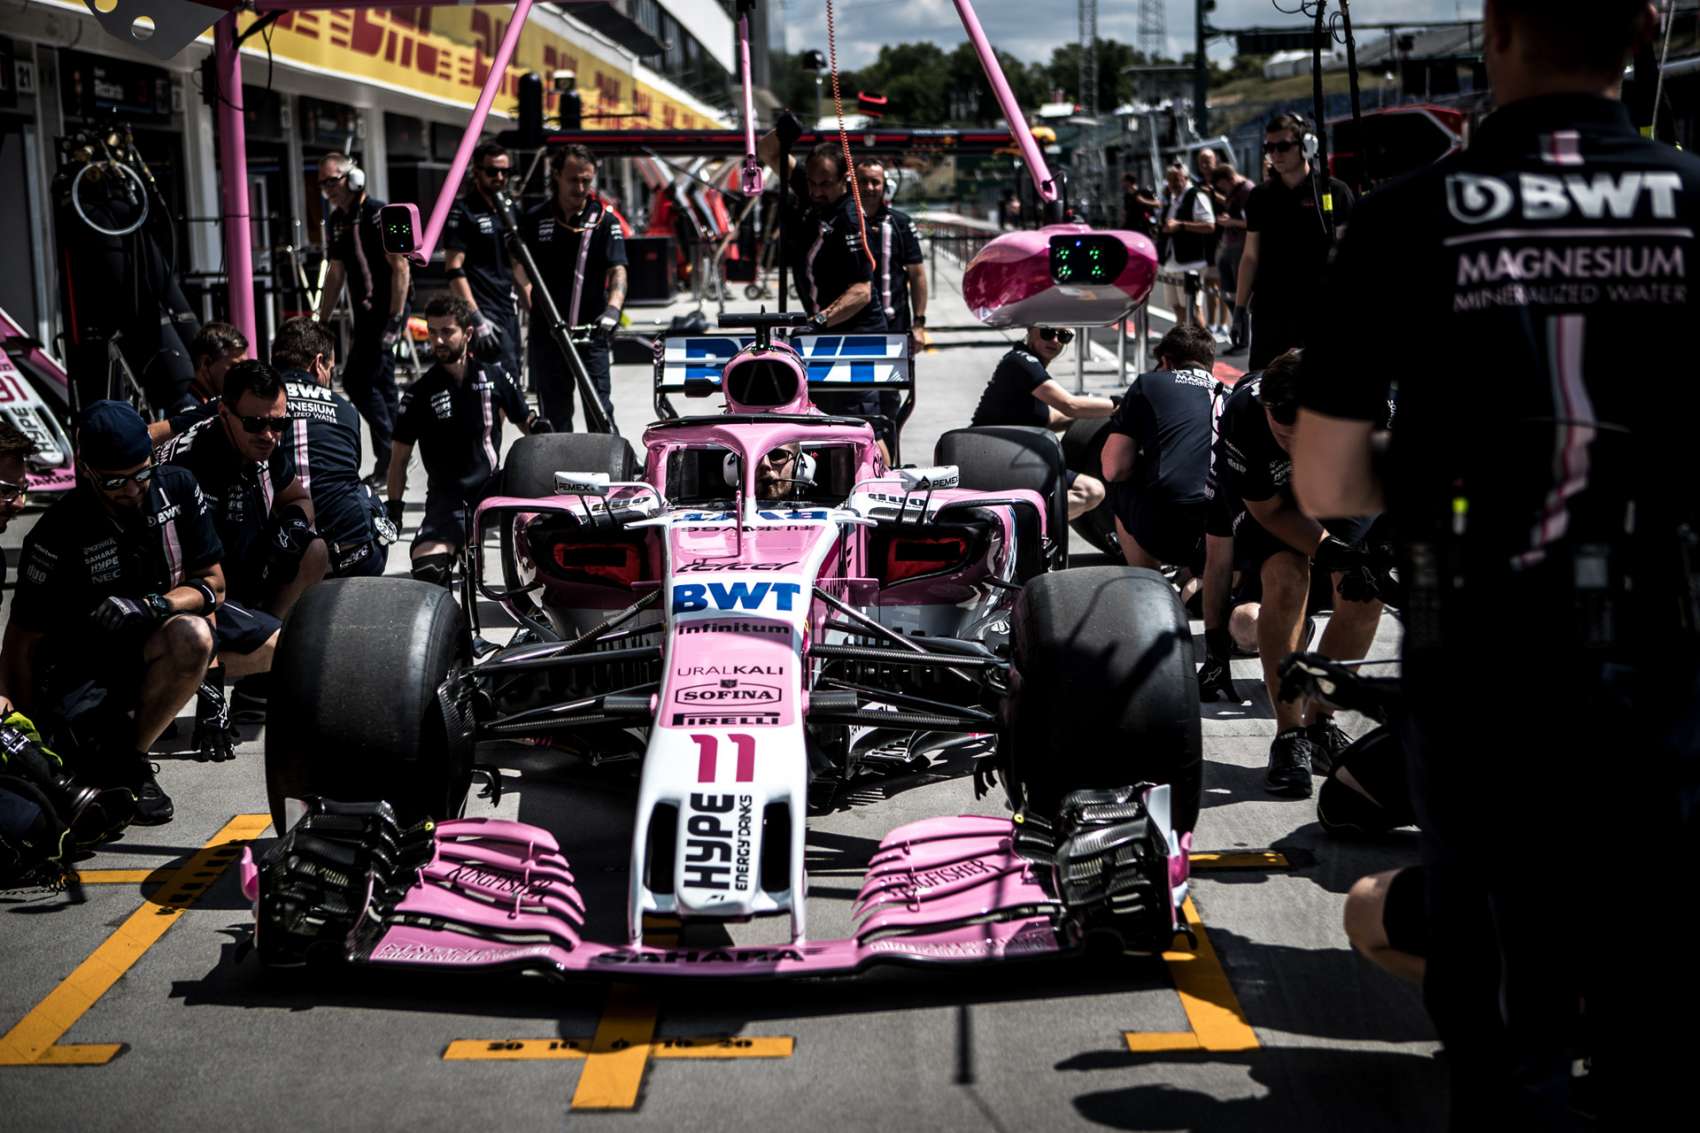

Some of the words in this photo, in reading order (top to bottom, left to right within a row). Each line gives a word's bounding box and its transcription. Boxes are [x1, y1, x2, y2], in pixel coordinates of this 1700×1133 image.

[1518, 170, 1683, 220] BWT
[1456, 245, 1687, 286] MAGNESIUM
[1605, 283, 1688, 304] WATER
[285, 382, 332, 401] BWT
[287, 401, 336, 417] NESIUM
[672, 582, 800, 615] BWT
[678, 623, 789, 635] infinitum
[678, 666, 783, 676] URALKALI
[684, 690, 774, 700] SOFINA
[672, 712, 780, 726] PIRELLI
[690, 733, 756, 783] 11
[683, 793, 735, 890] HYPE
[735, 838, 751, 891] ENERGY
